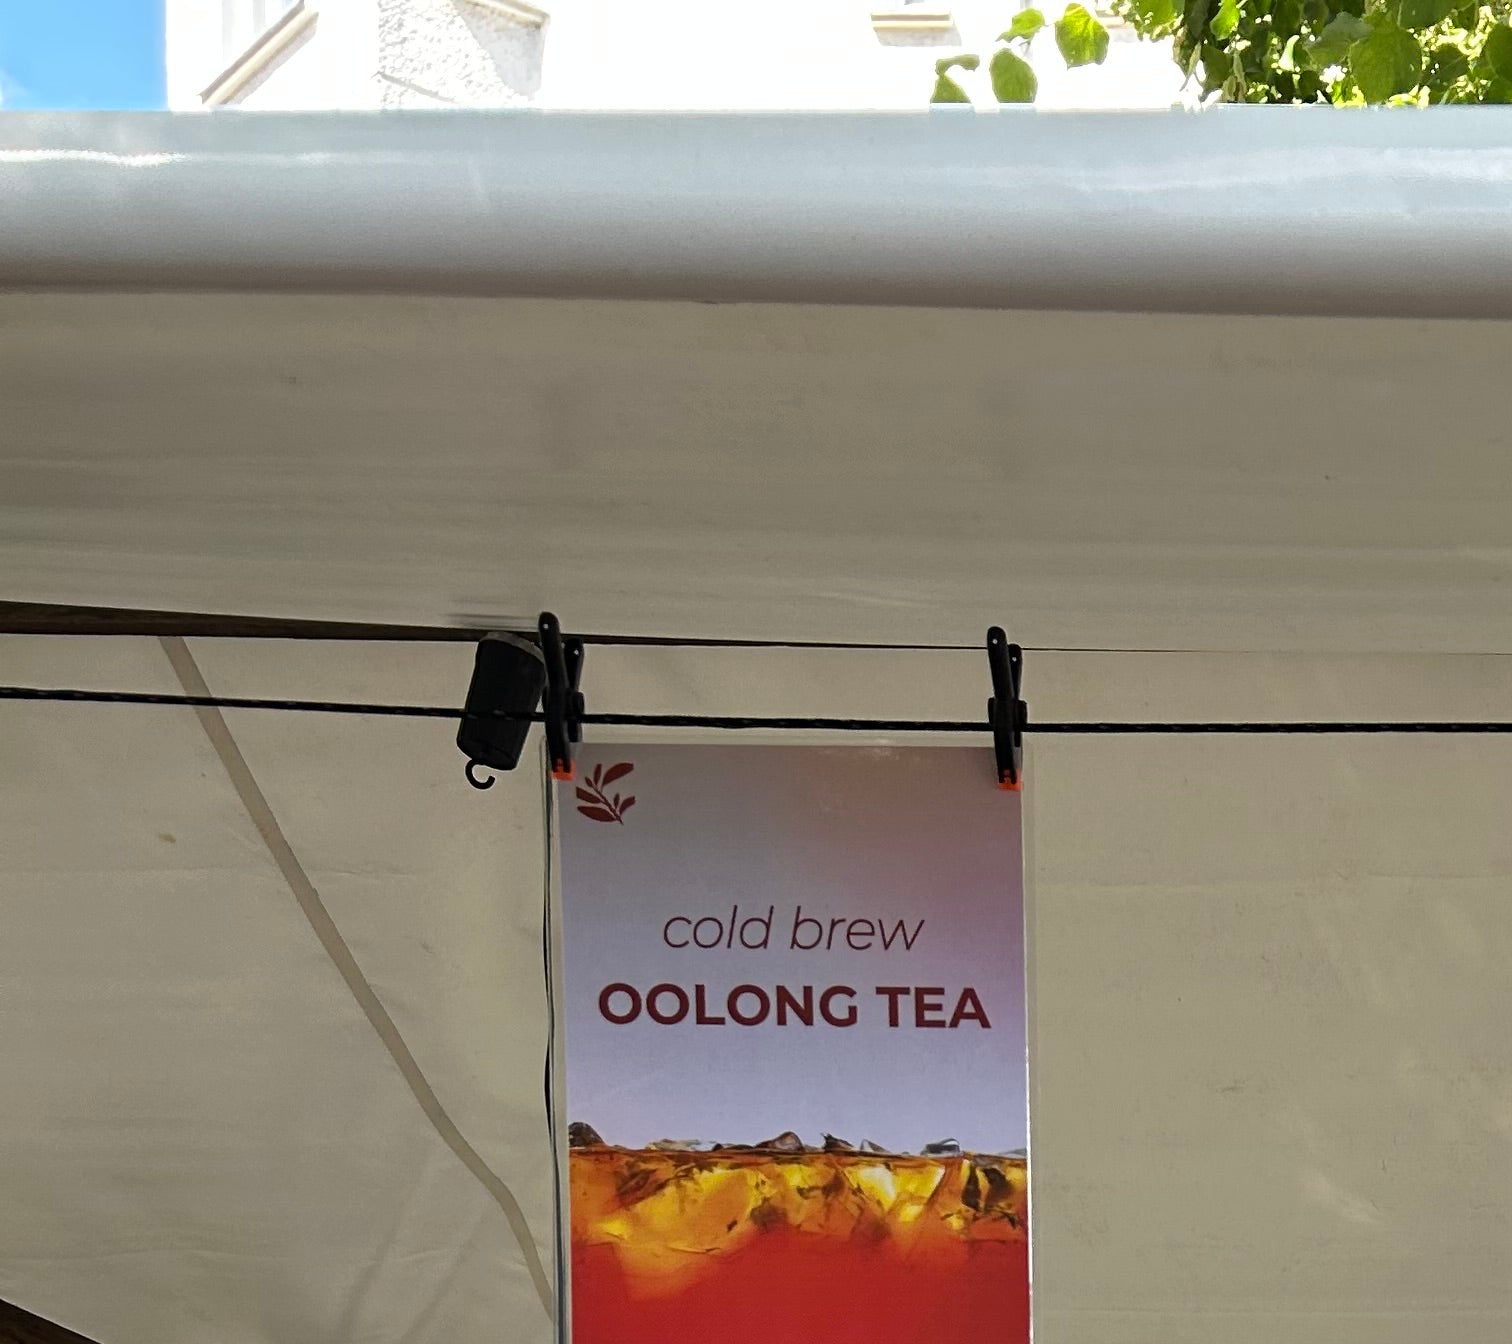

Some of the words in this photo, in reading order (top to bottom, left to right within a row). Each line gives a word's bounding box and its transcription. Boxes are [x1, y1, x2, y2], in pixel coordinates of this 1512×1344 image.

[664, 905, 773, 950] cold
[790, 907, 925, 951] brew
[598, 983, 859, 1028] OOLONG
[876, 986, 992, 1029] TEA
